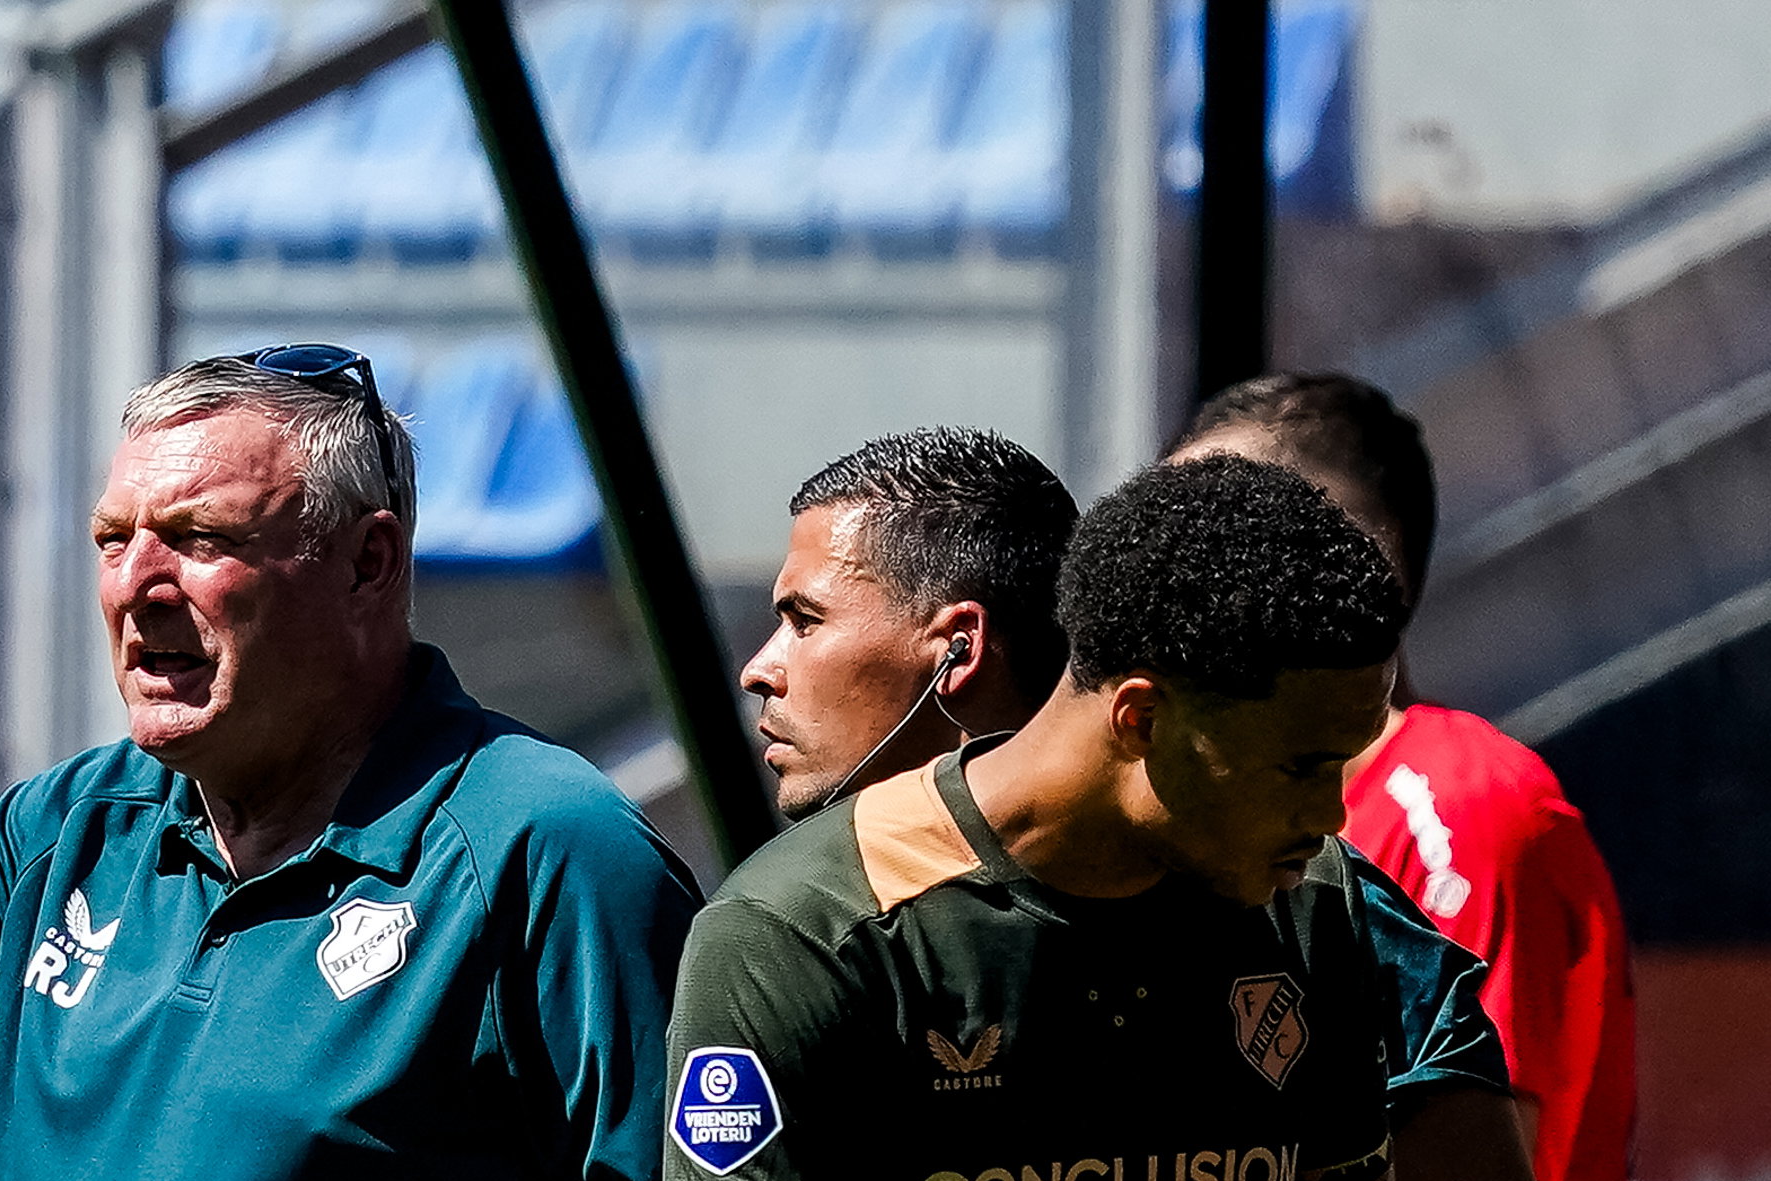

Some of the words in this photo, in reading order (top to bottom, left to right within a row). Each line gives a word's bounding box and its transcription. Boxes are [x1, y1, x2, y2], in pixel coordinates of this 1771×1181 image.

[24, 941, 98, 1009] RJ
[933, 1075, 1003, 1091] CASTORE
[684, 1111, 762, 1128] VRIENDEN
[691, 1126, 753, 1144] LOTERIJ
